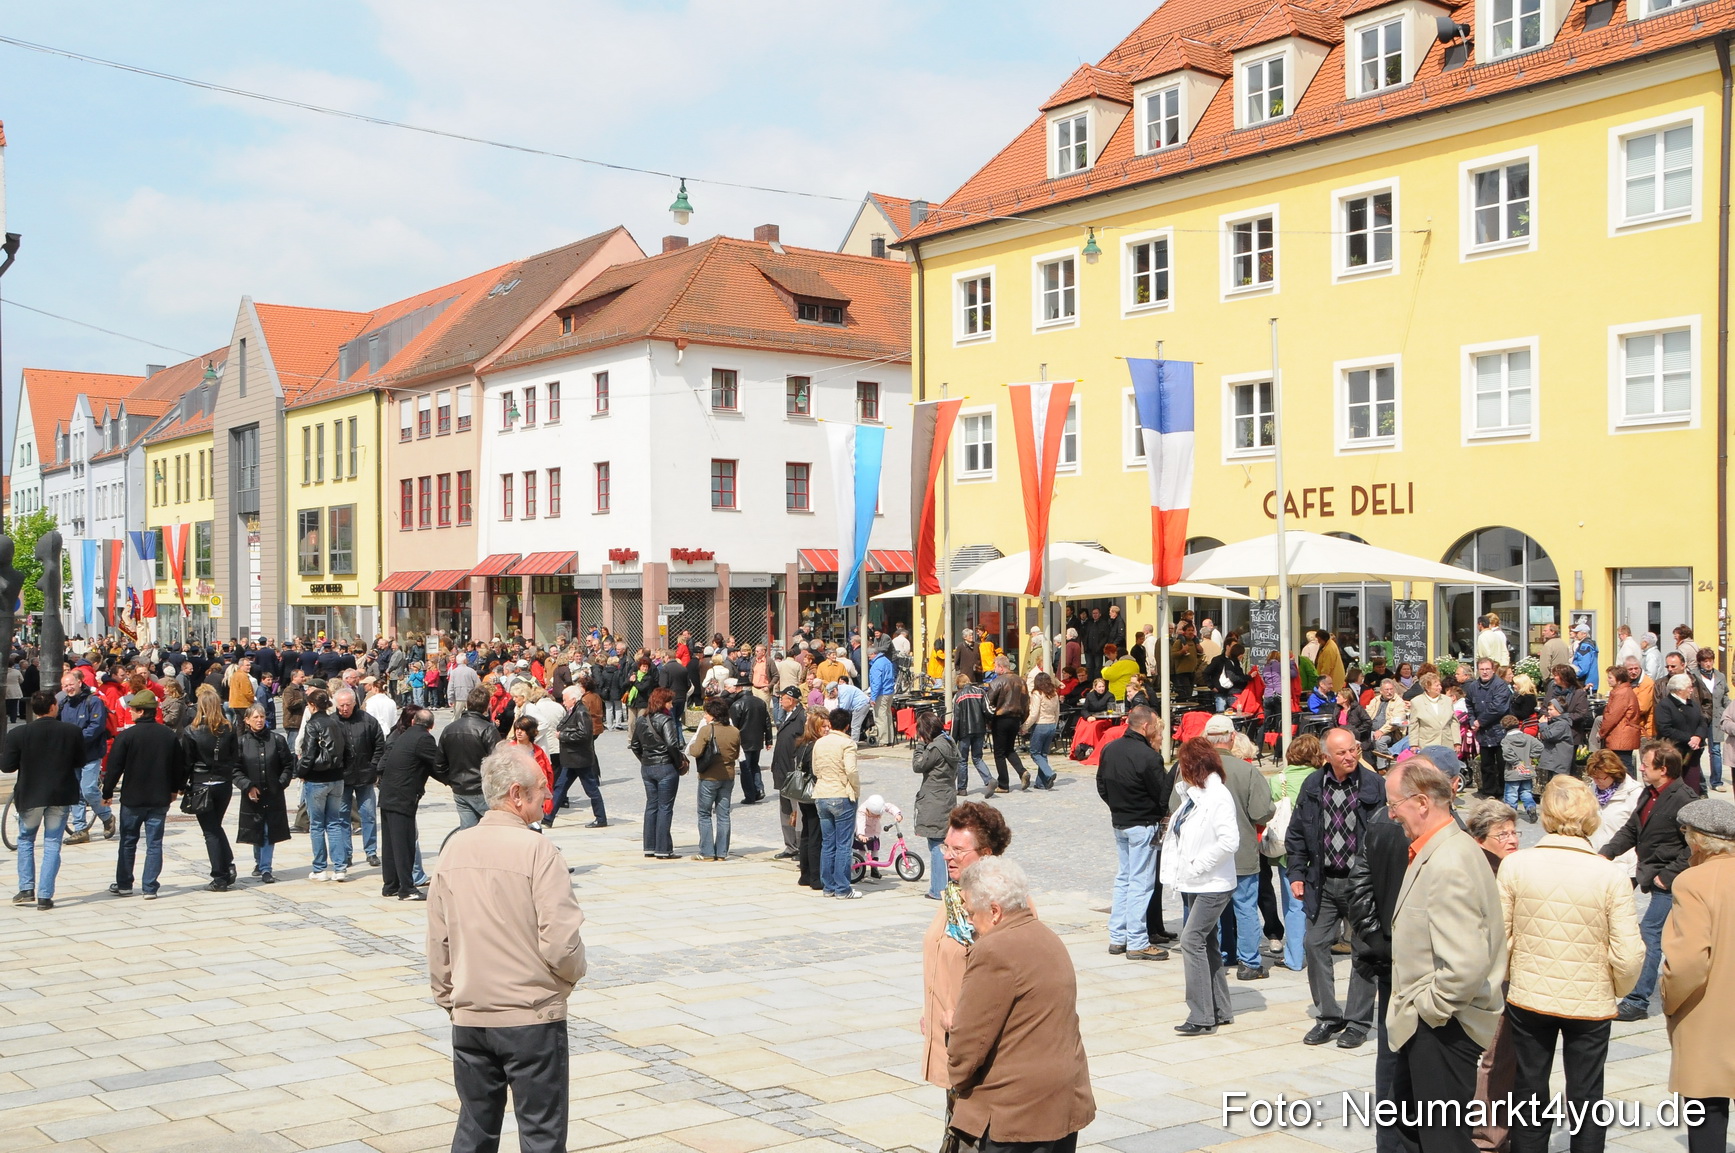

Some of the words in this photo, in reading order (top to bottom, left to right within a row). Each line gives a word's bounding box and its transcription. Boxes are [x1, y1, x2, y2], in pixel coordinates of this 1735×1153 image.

[1263, 486, 1335, 520] CAFE
[1351, 482, 1413, 516] DELI
[608, 547, 639, 566] Döpfer
[670, 547, 715, 565] Döpfer
[1697, 580, 1714, 592] 24
